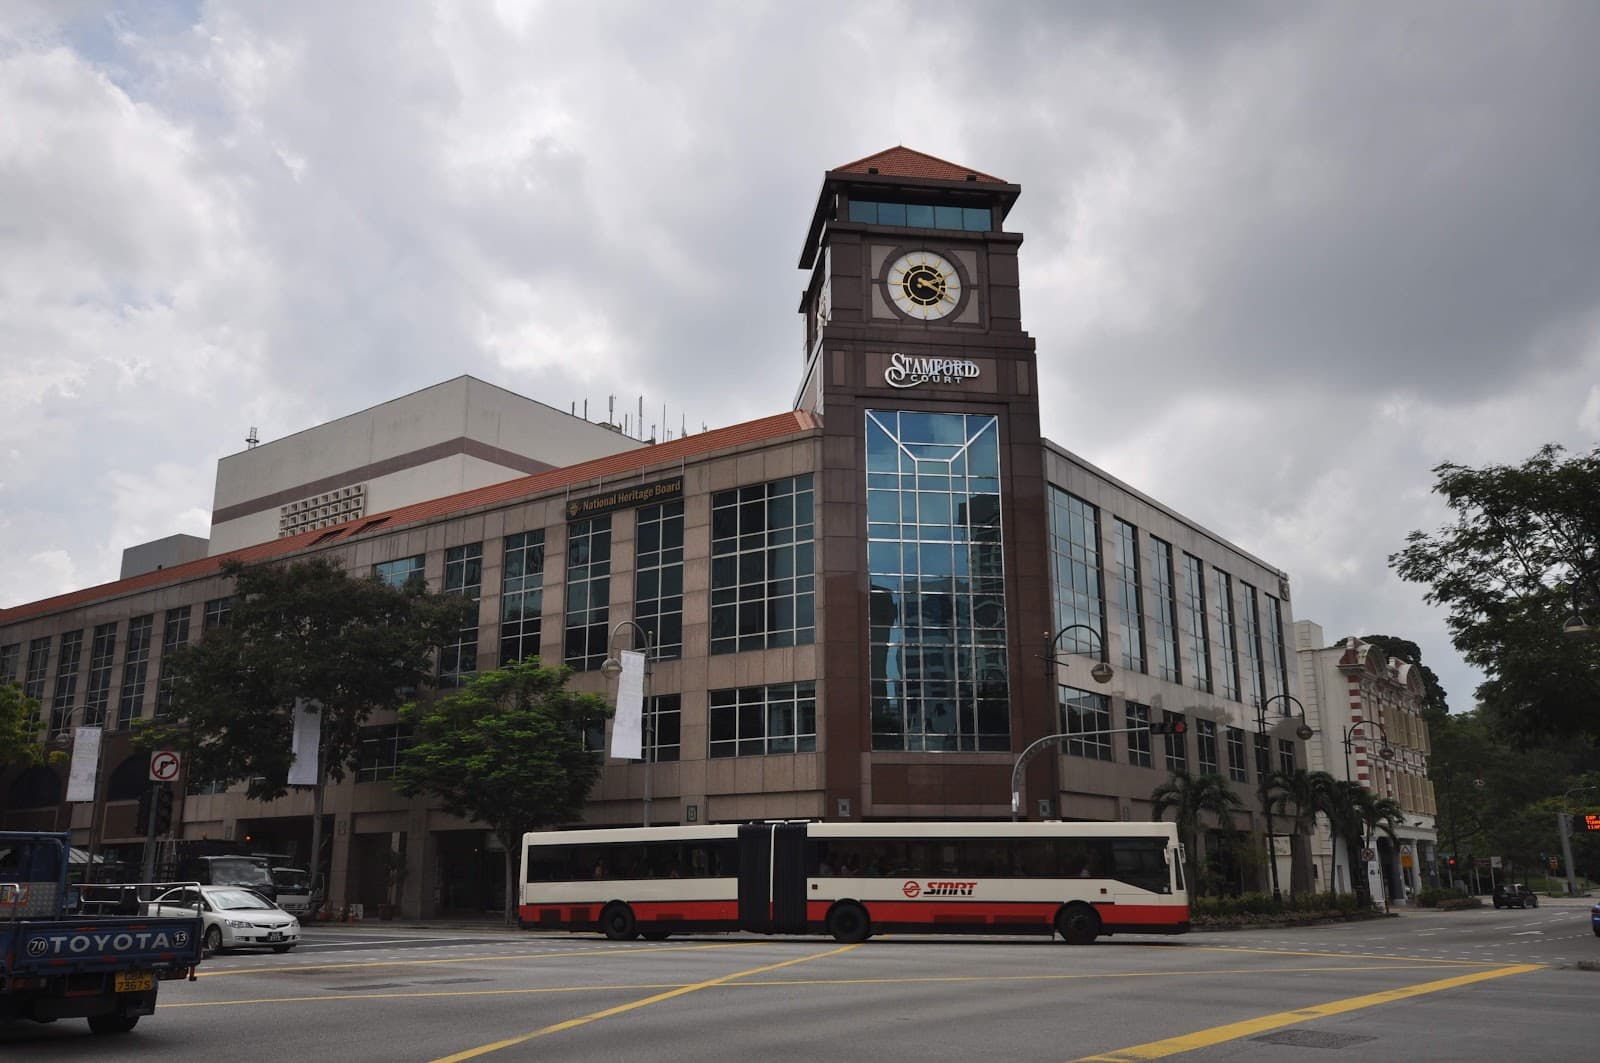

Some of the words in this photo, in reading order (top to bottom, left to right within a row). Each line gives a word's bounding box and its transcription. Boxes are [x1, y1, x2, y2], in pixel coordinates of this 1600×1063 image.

[910, 374, 963, 384] COURT
[583, 496, 616, 510] National
[618, 487, 654, 503] Heritage
[655, 480, 681, 496] Board
[923, 882, 978, 895] SMRT
[50, 933, 171, 953] TOYOTA
[175, 933, 186, 942] 13
[31, 940, 46, 952] 70
